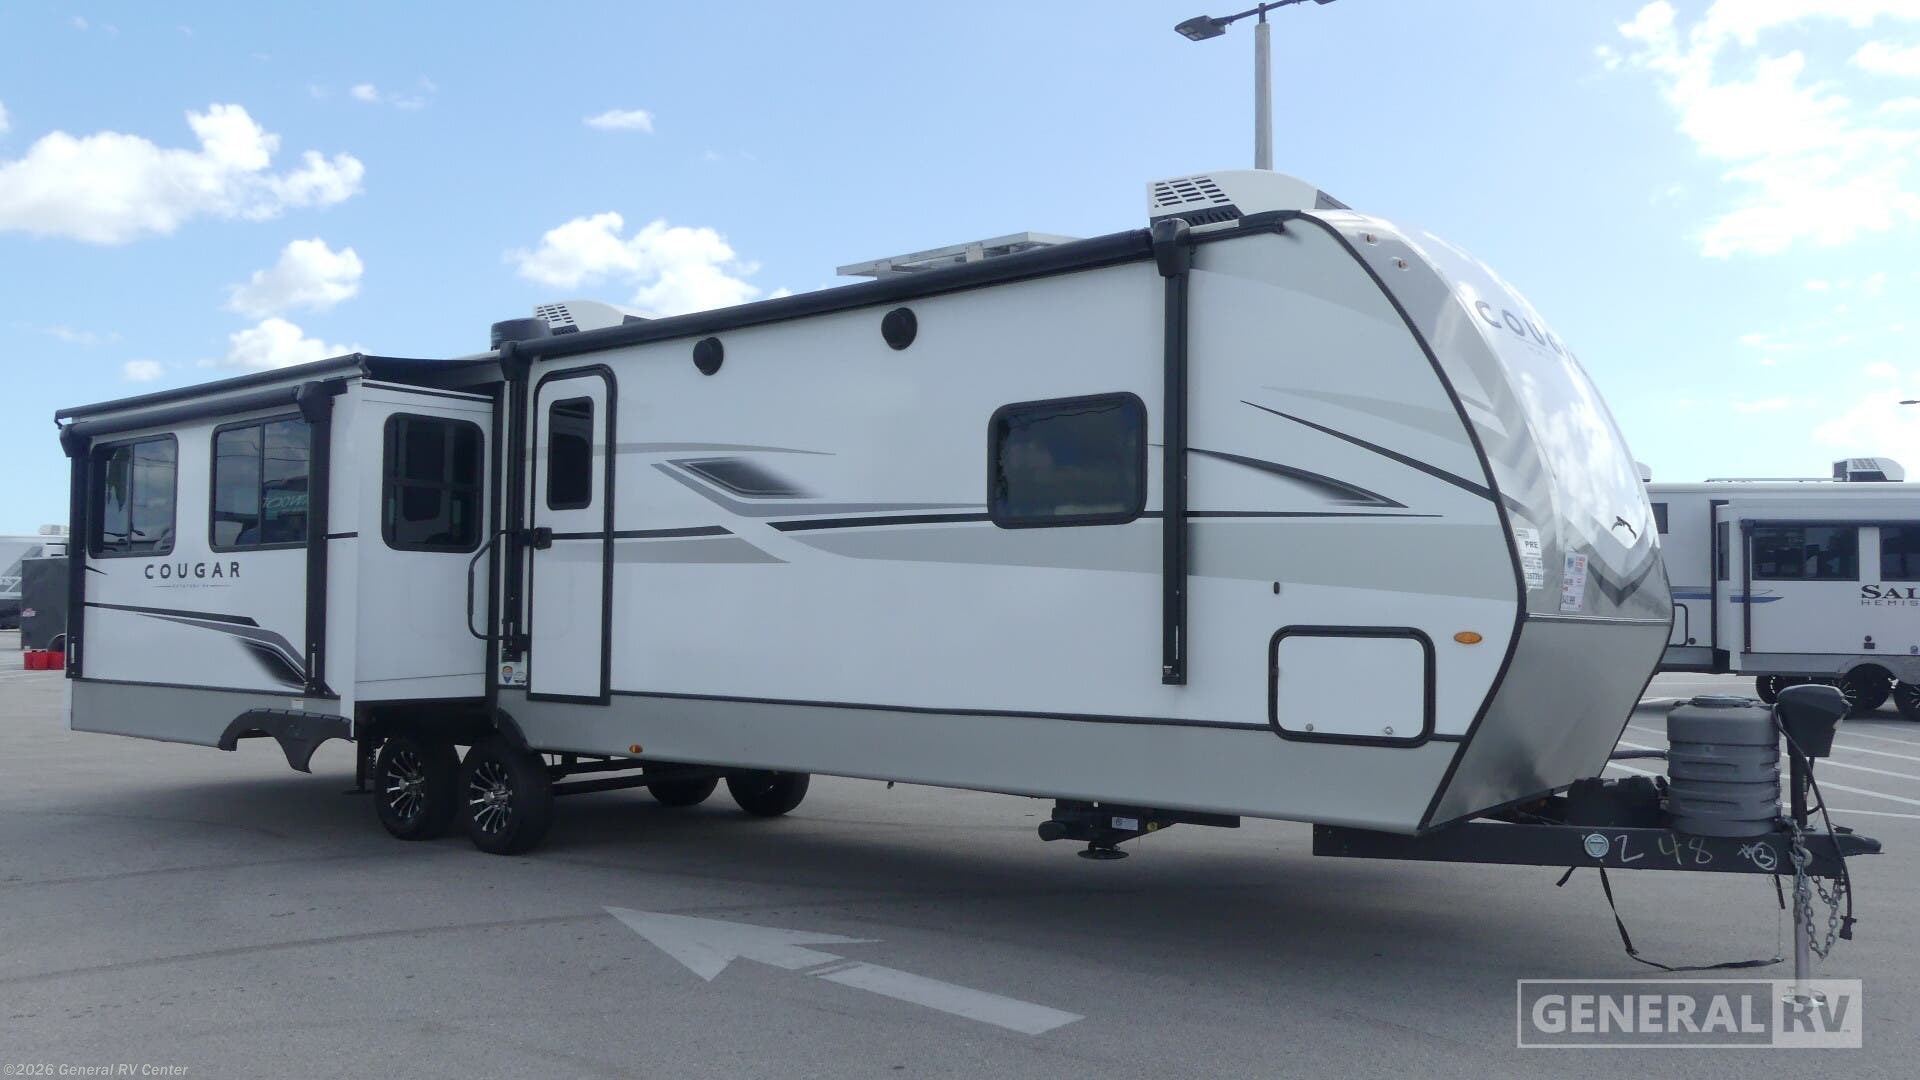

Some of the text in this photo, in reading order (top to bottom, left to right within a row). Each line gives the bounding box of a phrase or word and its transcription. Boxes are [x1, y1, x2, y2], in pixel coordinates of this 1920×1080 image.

[1524, 540, 1540, 550] PRE
[144, 561, 241, 579] COUGAR
[1861, 584, 1920, 599] SAL
